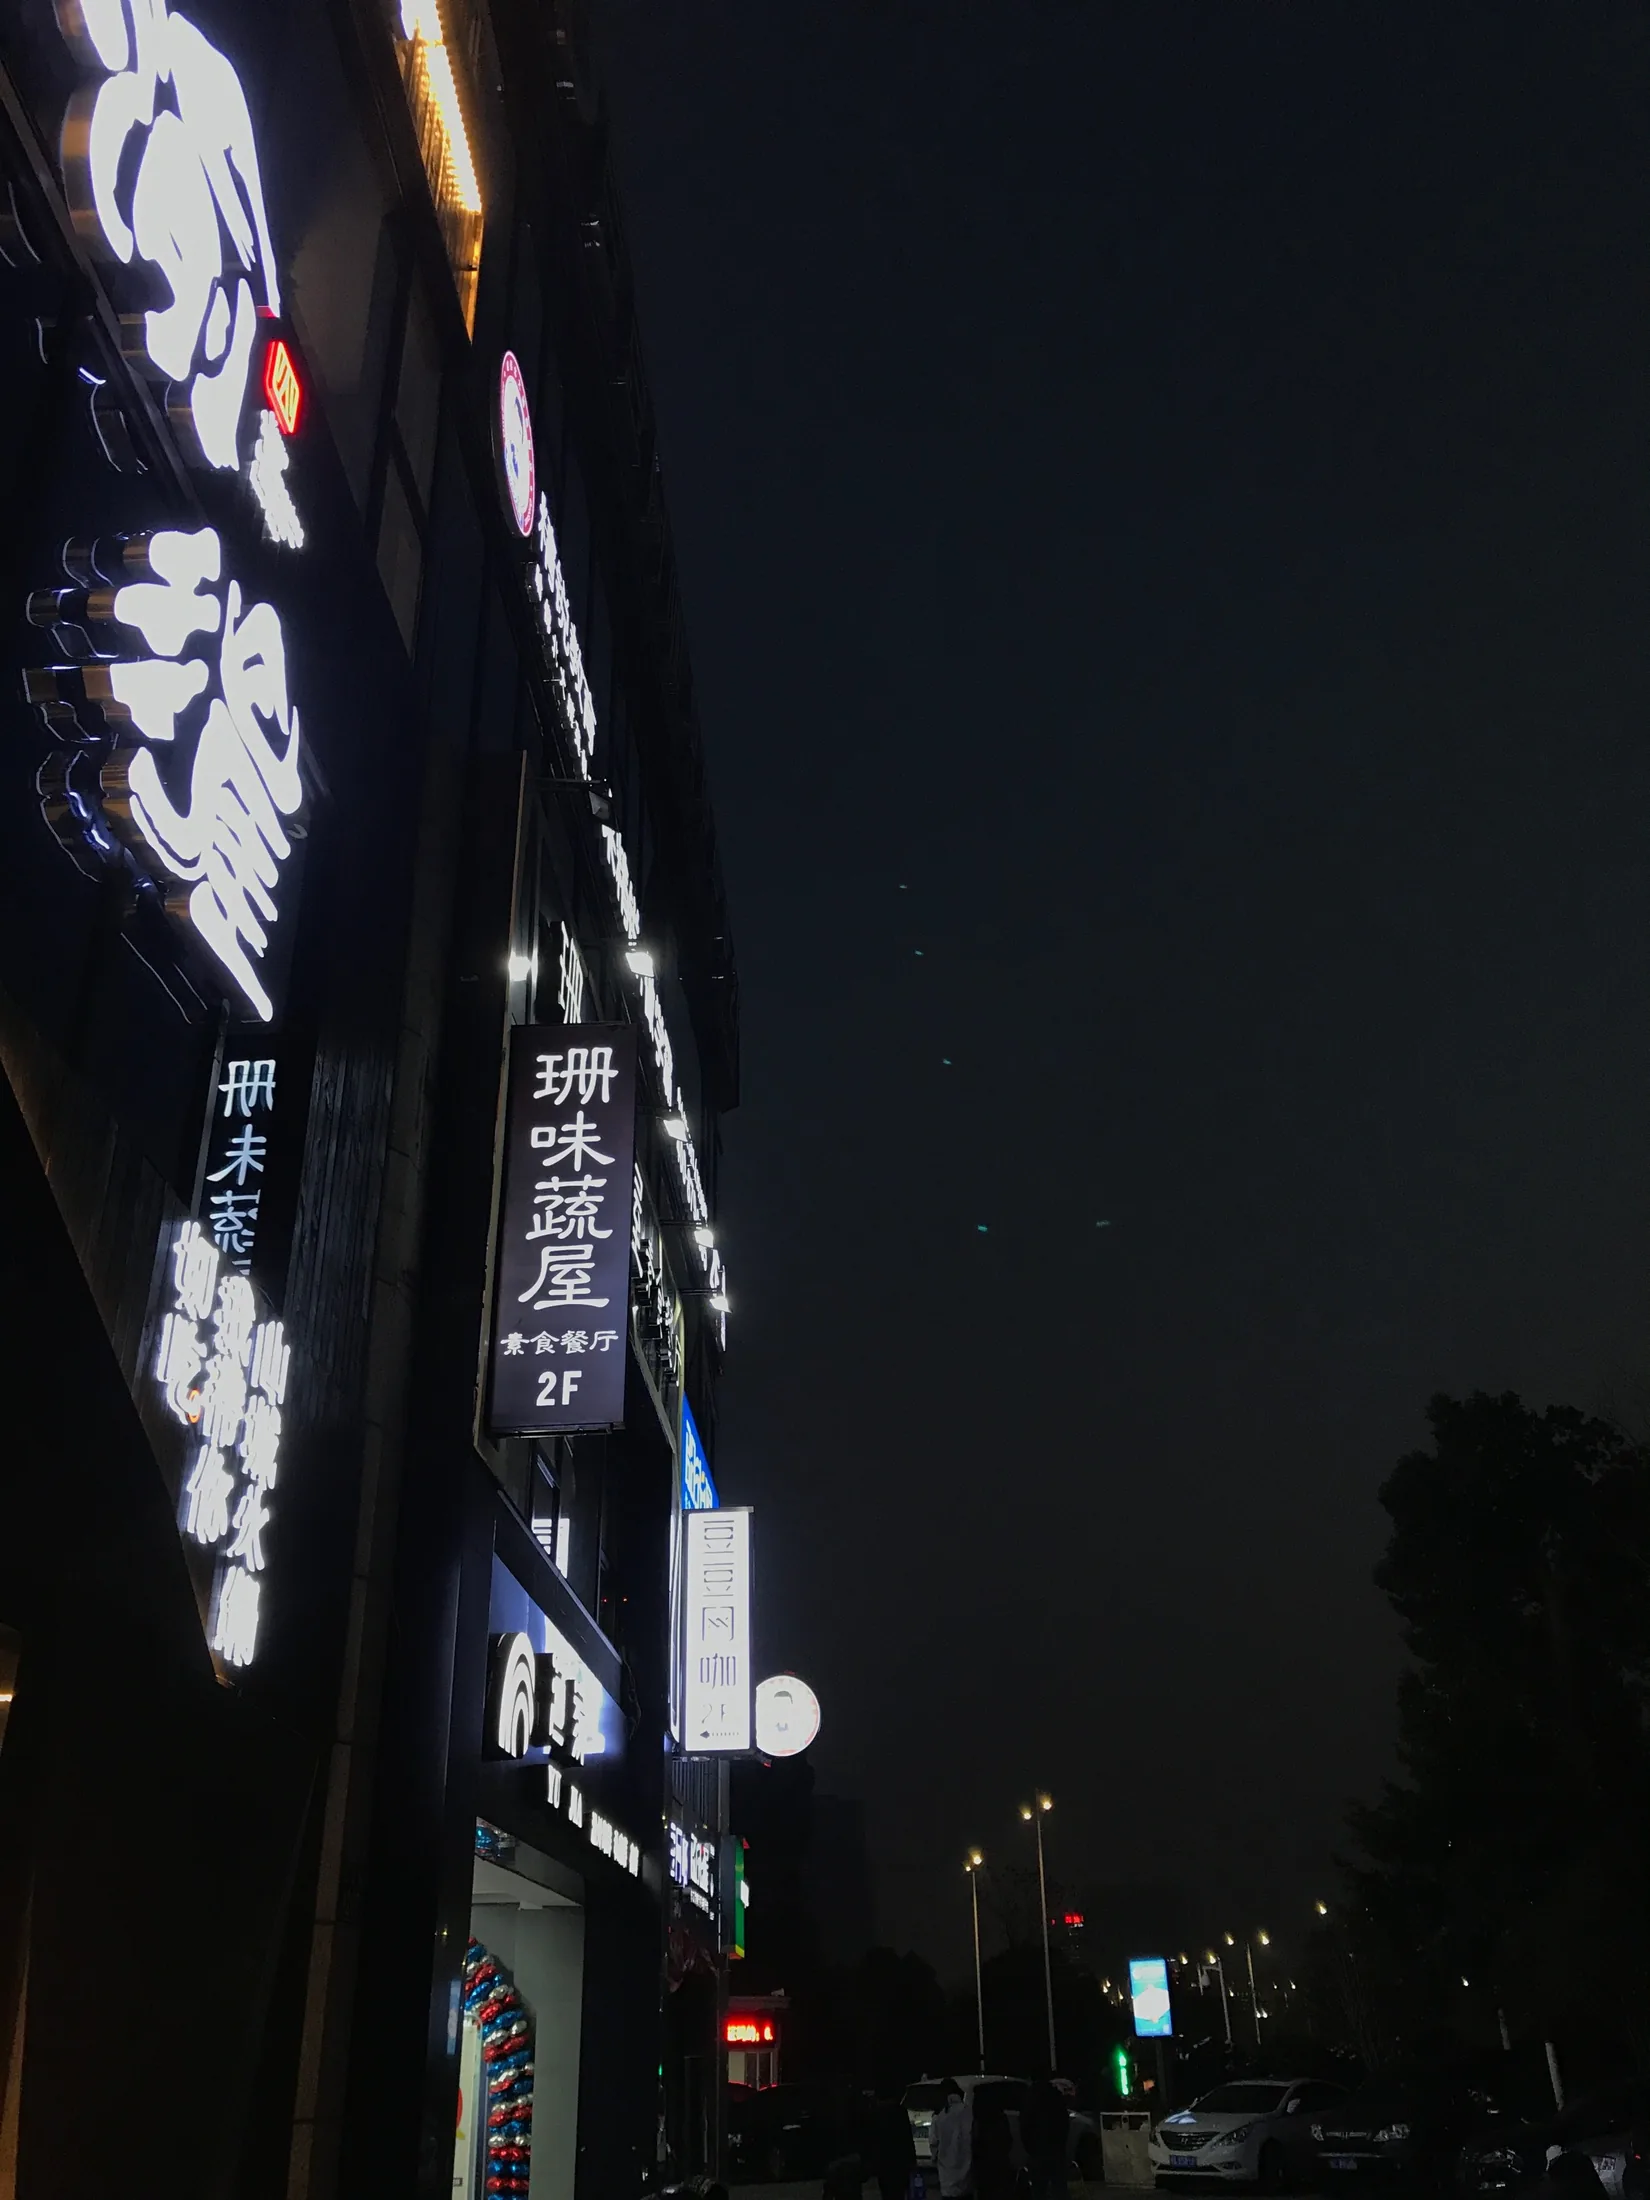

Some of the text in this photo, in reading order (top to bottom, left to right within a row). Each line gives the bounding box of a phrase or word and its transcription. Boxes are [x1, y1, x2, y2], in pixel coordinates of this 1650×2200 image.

[517, 1046, 619, 1311] 珊味蔬屋
[499, 1329, 619, 1356] 素食餐厅
[535, 1370, 583, 1407] 2F
